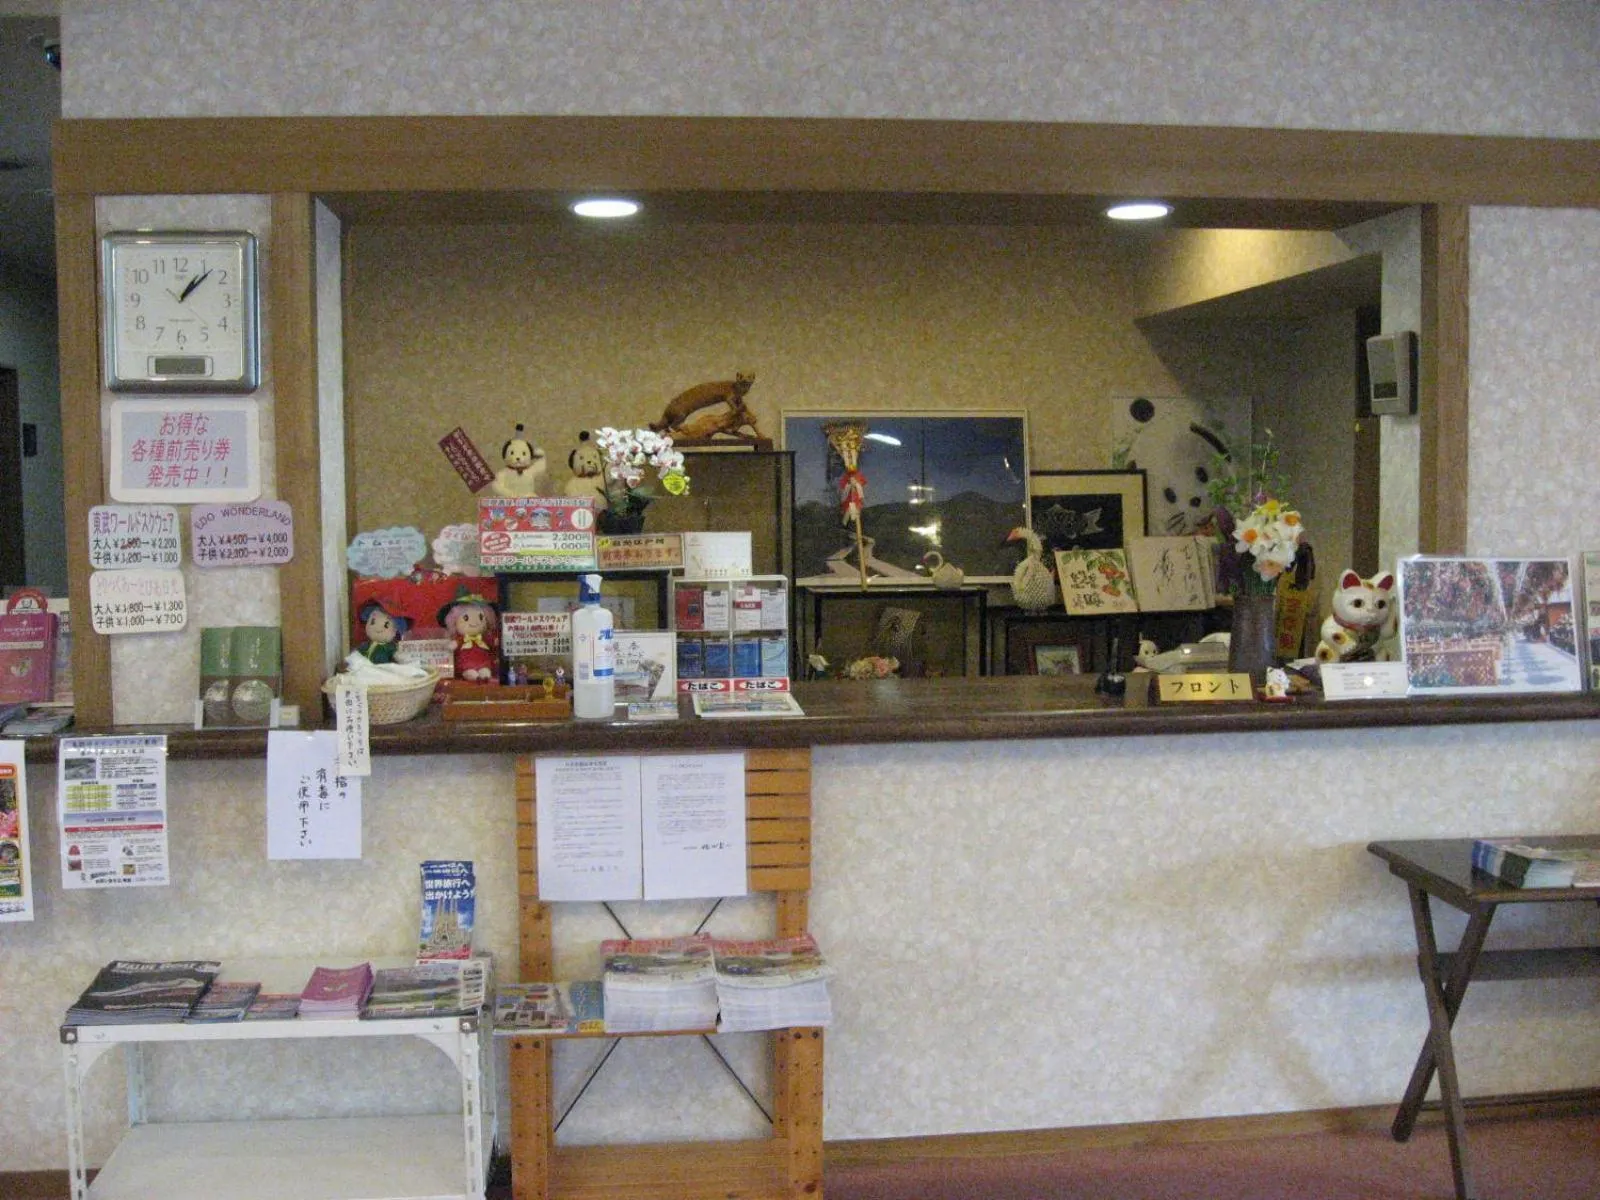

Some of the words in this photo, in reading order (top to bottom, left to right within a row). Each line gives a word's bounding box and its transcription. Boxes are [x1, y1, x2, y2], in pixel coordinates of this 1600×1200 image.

[152, 258, 166, 274] 11
[173, 257, 189, 273] 12
[200, 258, 207, 274] 1
[133, 268, 150, 285] 10
[218, 270, 228, 285] 2
[130, 292, 141, 308] 9
[222, 292, 231, 308] 3
[135, 315, 146, 331] 8
[217, 316, 228, 332] 4
[155, 326, 165, 341] 7
[176, 329, 188, 344] 6
[200, 326, 209, 342] 5
[159, 412, 210, 436] お得な
[131, 437, 233, 462] 各種前売り券
[194, 512, 216, 530] EDO
[220, 506, 291, 526] WONDERLAND
[687, 682, 720, 691] たばこ
[745, 681, 778, 690] たばこ
[1170, 678, 1240, 695] フロント
